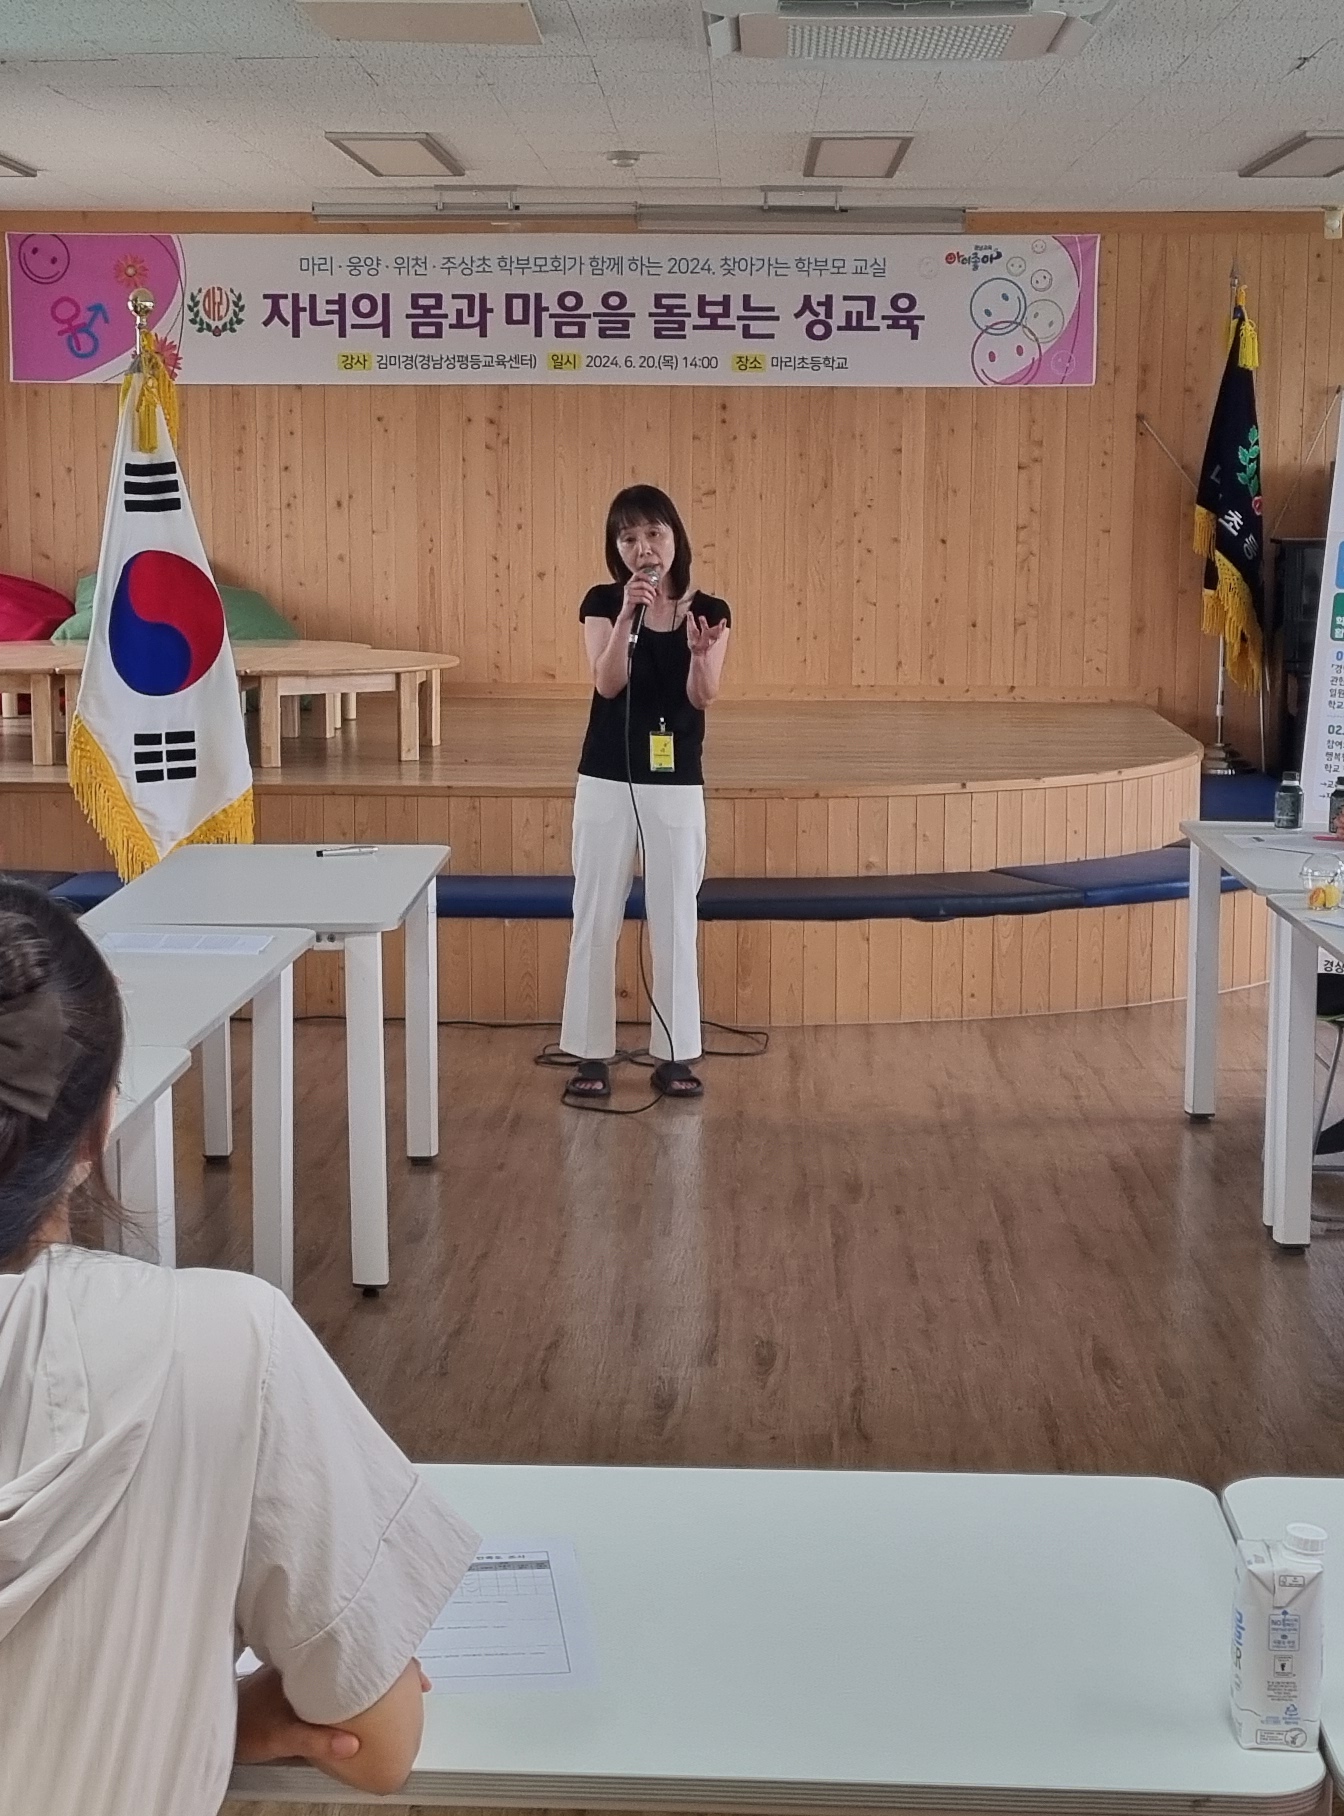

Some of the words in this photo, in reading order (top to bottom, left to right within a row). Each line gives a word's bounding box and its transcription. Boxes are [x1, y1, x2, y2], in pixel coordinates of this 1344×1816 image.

[497, 255, 584, 277] 학부모회가
[589, 255, 623, 277] 함께
[628, 255, 663, 277] 하는
[668, 257, 715, 276] 2024.
[720, 255, 792, 278] 찾아가는
[795, 255, 849, 278] 학부모
[853, 256, 888, 278] 교실
[262, 292, 389, 339] 자녀의
[406, 292, 494, 339] 몸과
[505, 291, 636, 340] 마음을
[648, 292, 781, 340] 돌보는
[794, 291, 926, 341] 성교육
[341, 353, 368, 370] 강사
[376, 352, 537, 370] 김미경(경남성평등교육센터)
[552, 354, 577, 370] 일시
[586, 355, 621, 369] 2024.
[682, 355, 718, 369] 14:00
[735, 354, 763, 371] 장소
[771, 354, 849, 371] 마리초등학교
[1327, 724, 1344, 736] 02.
